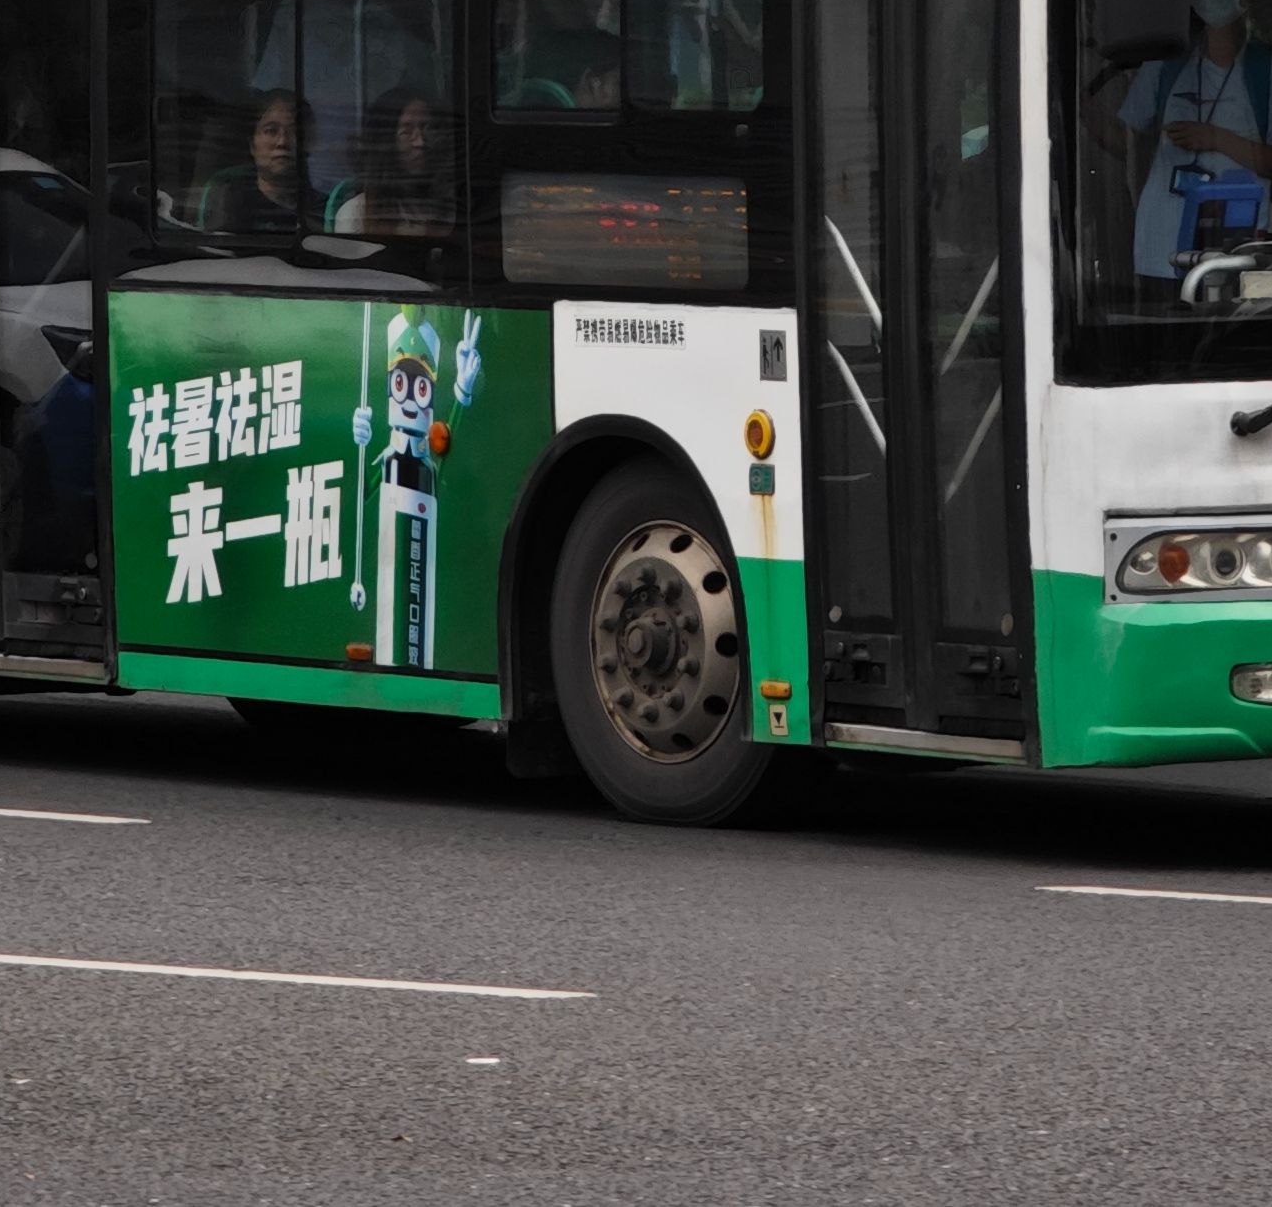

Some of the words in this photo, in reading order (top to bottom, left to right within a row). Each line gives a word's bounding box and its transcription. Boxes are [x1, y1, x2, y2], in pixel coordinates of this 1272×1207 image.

[127, 360, 303, 477] 祛暑祛湿
[165, 460, 344, 604] 来一瓶
